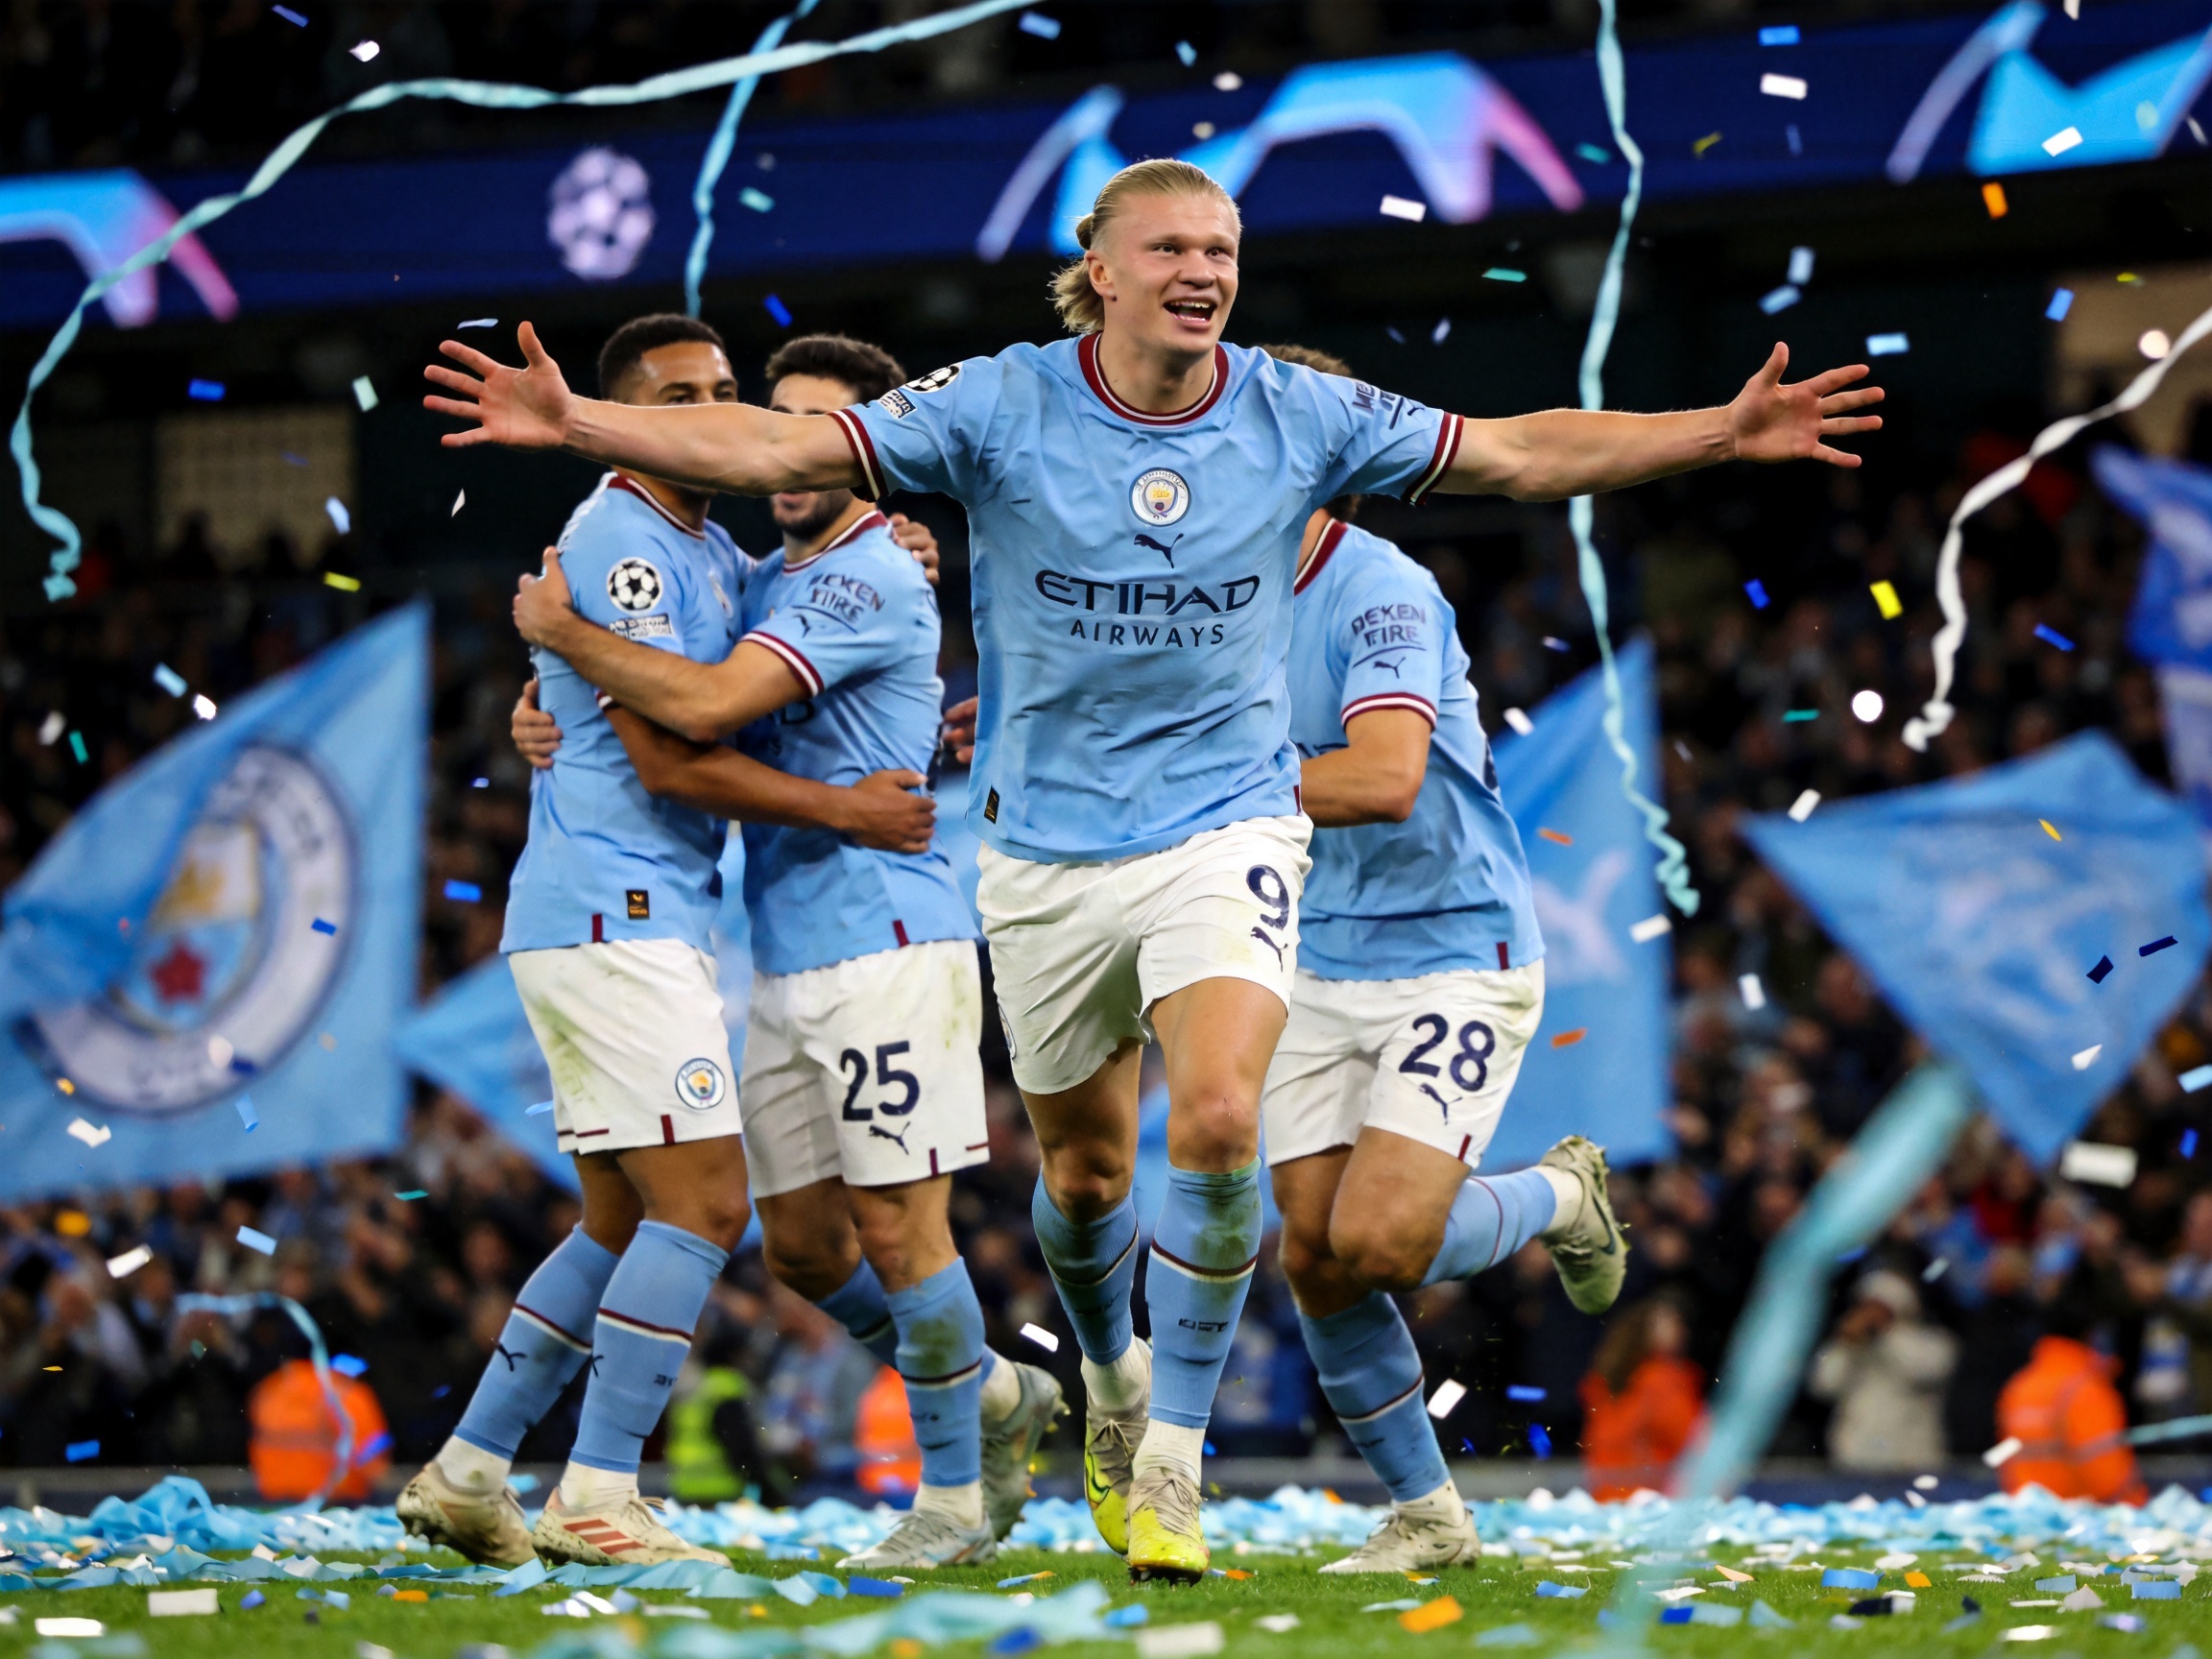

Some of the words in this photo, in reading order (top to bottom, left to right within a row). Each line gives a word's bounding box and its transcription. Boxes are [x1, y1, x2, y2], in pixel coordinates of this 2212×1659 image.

[1034, 569, 1261, 615] ETIHAD
[1070, 618, 1224, 648] AIRWAYS
[1245, 864, 1290, 931] 9
[839, 1040, 921, 1122] 25
[1398, 1012, 1496, 1092] 28
